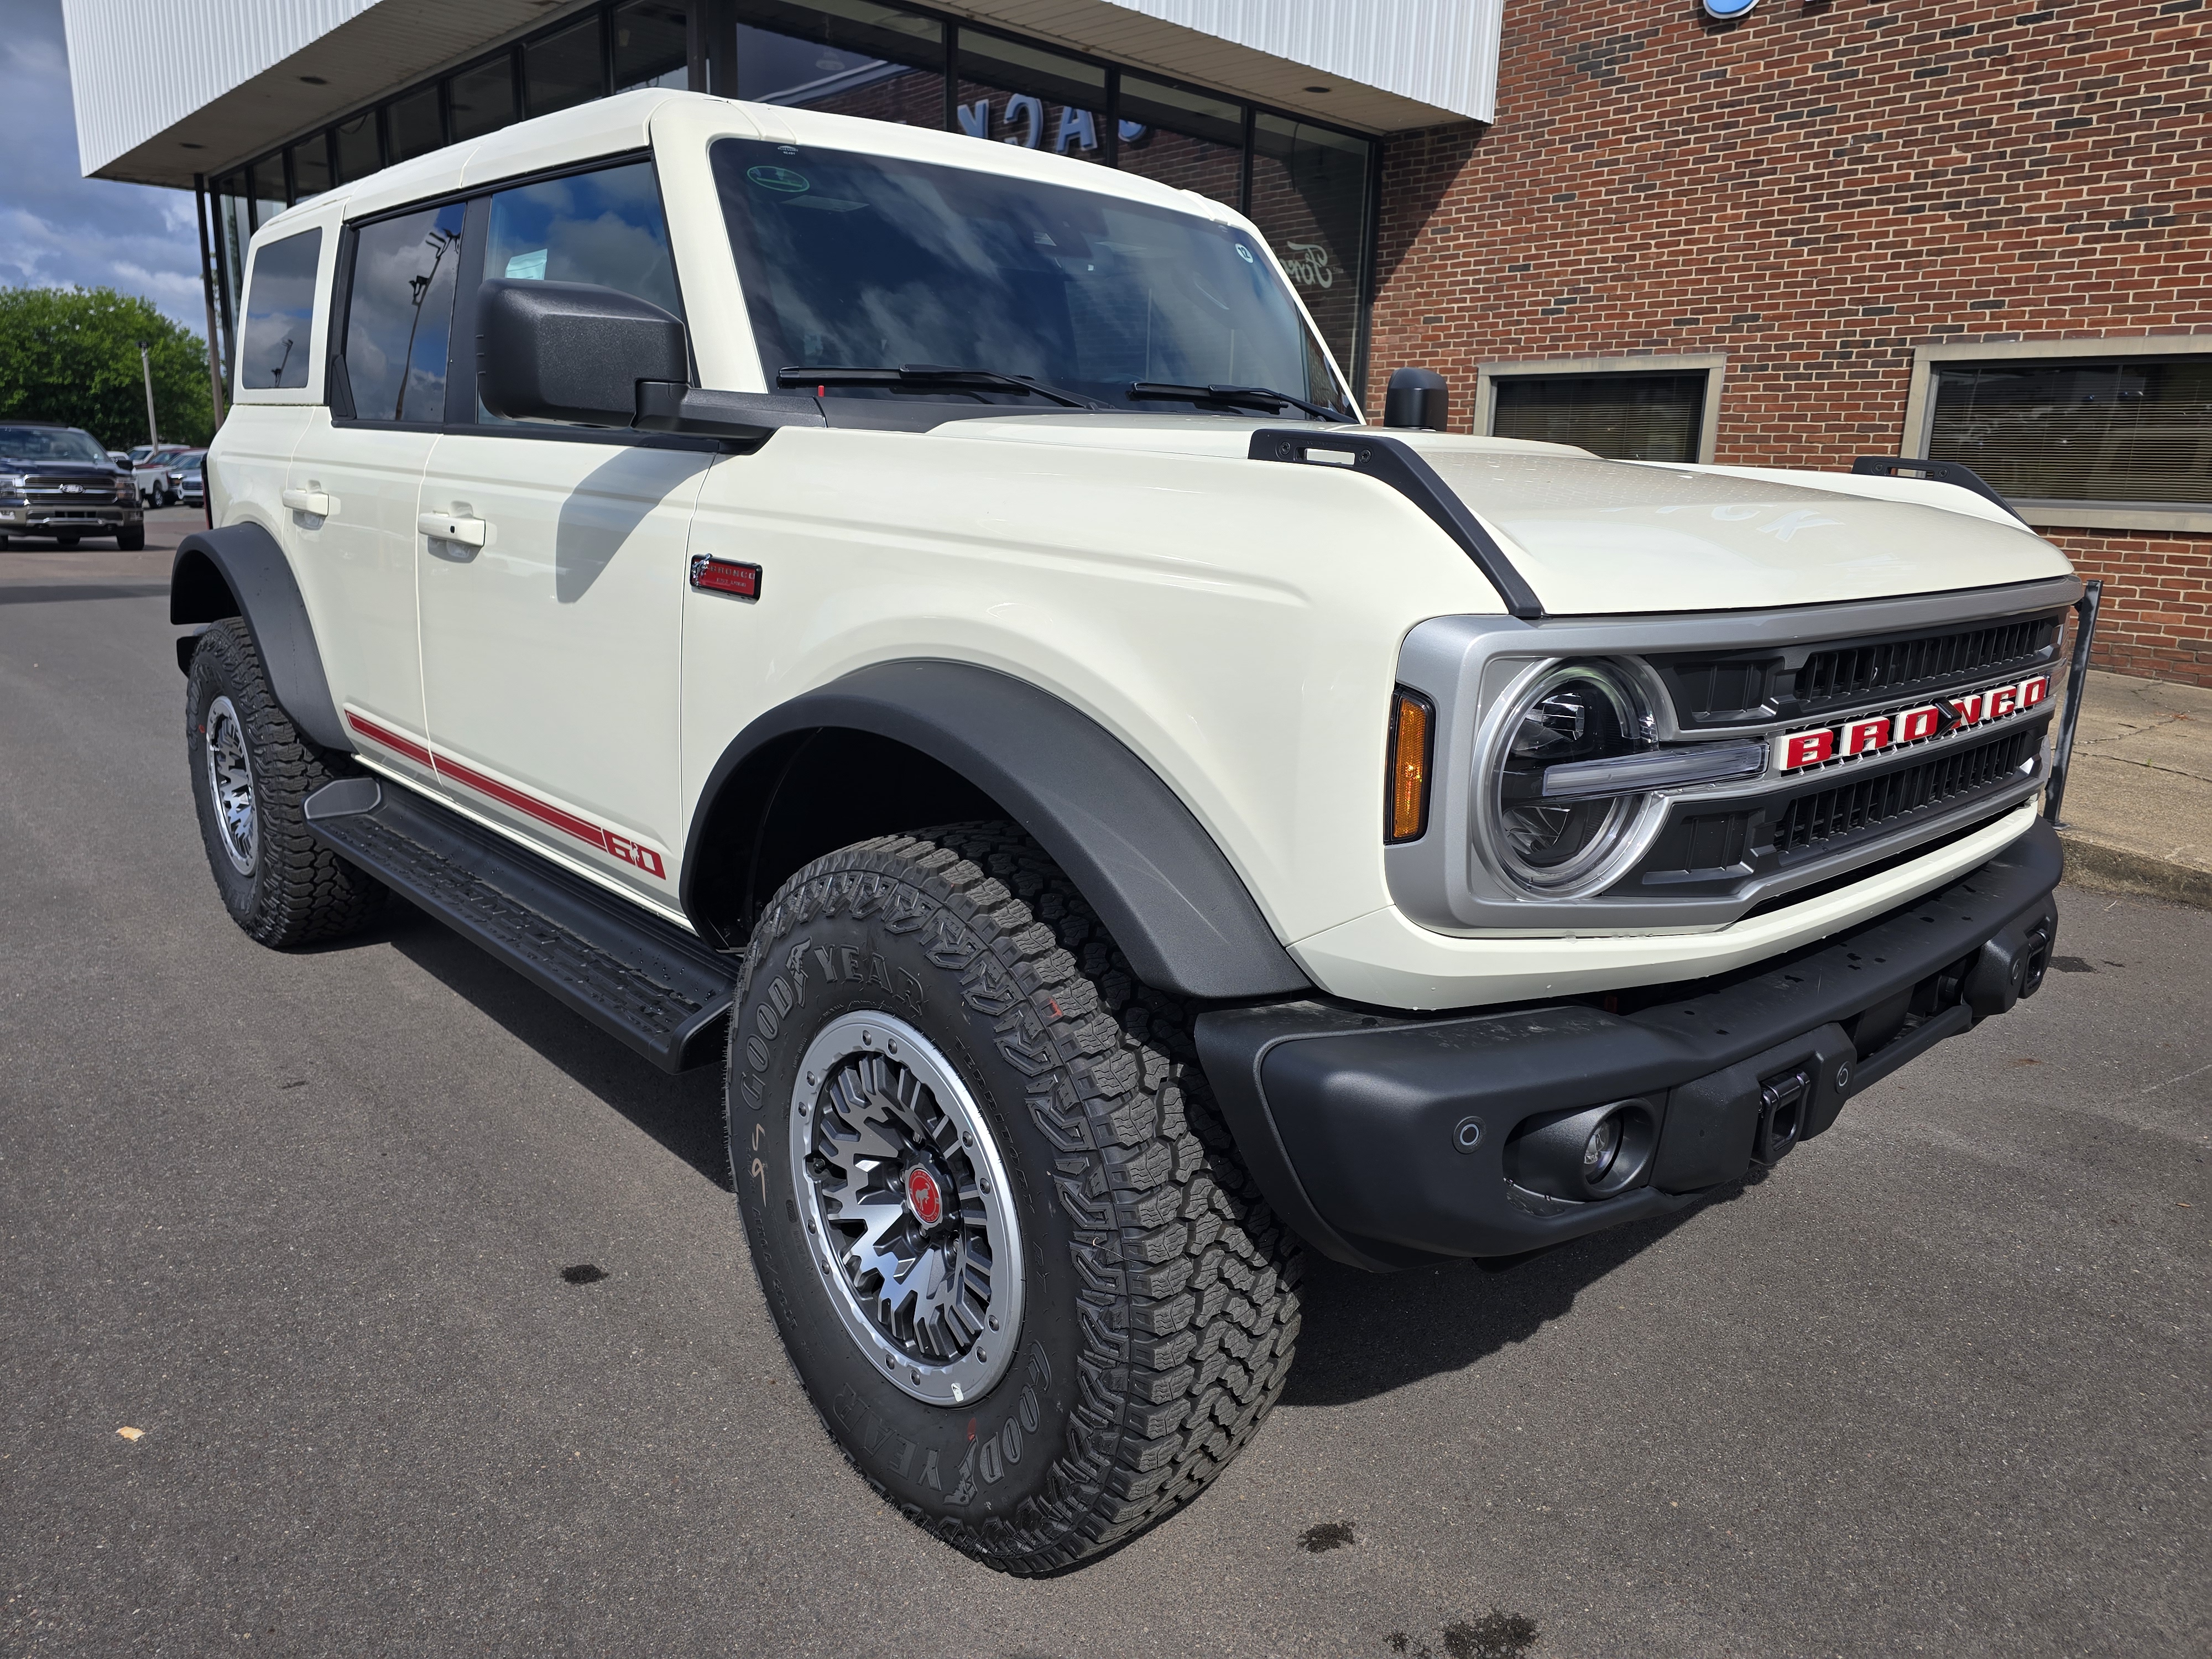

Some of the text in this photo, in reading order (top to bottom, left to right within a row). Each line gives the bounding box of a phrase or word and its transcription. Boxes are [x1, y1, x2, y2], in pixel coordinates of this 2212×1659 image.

[709, 565, 756, 580] BRONCO
[1779, 675, 2048, 771] BRONCO
[602, 828, 666, 880] 60
[954, 1035, 1036, 1215] TERRITORY
[914, 1171, 931, 1182] FORD
